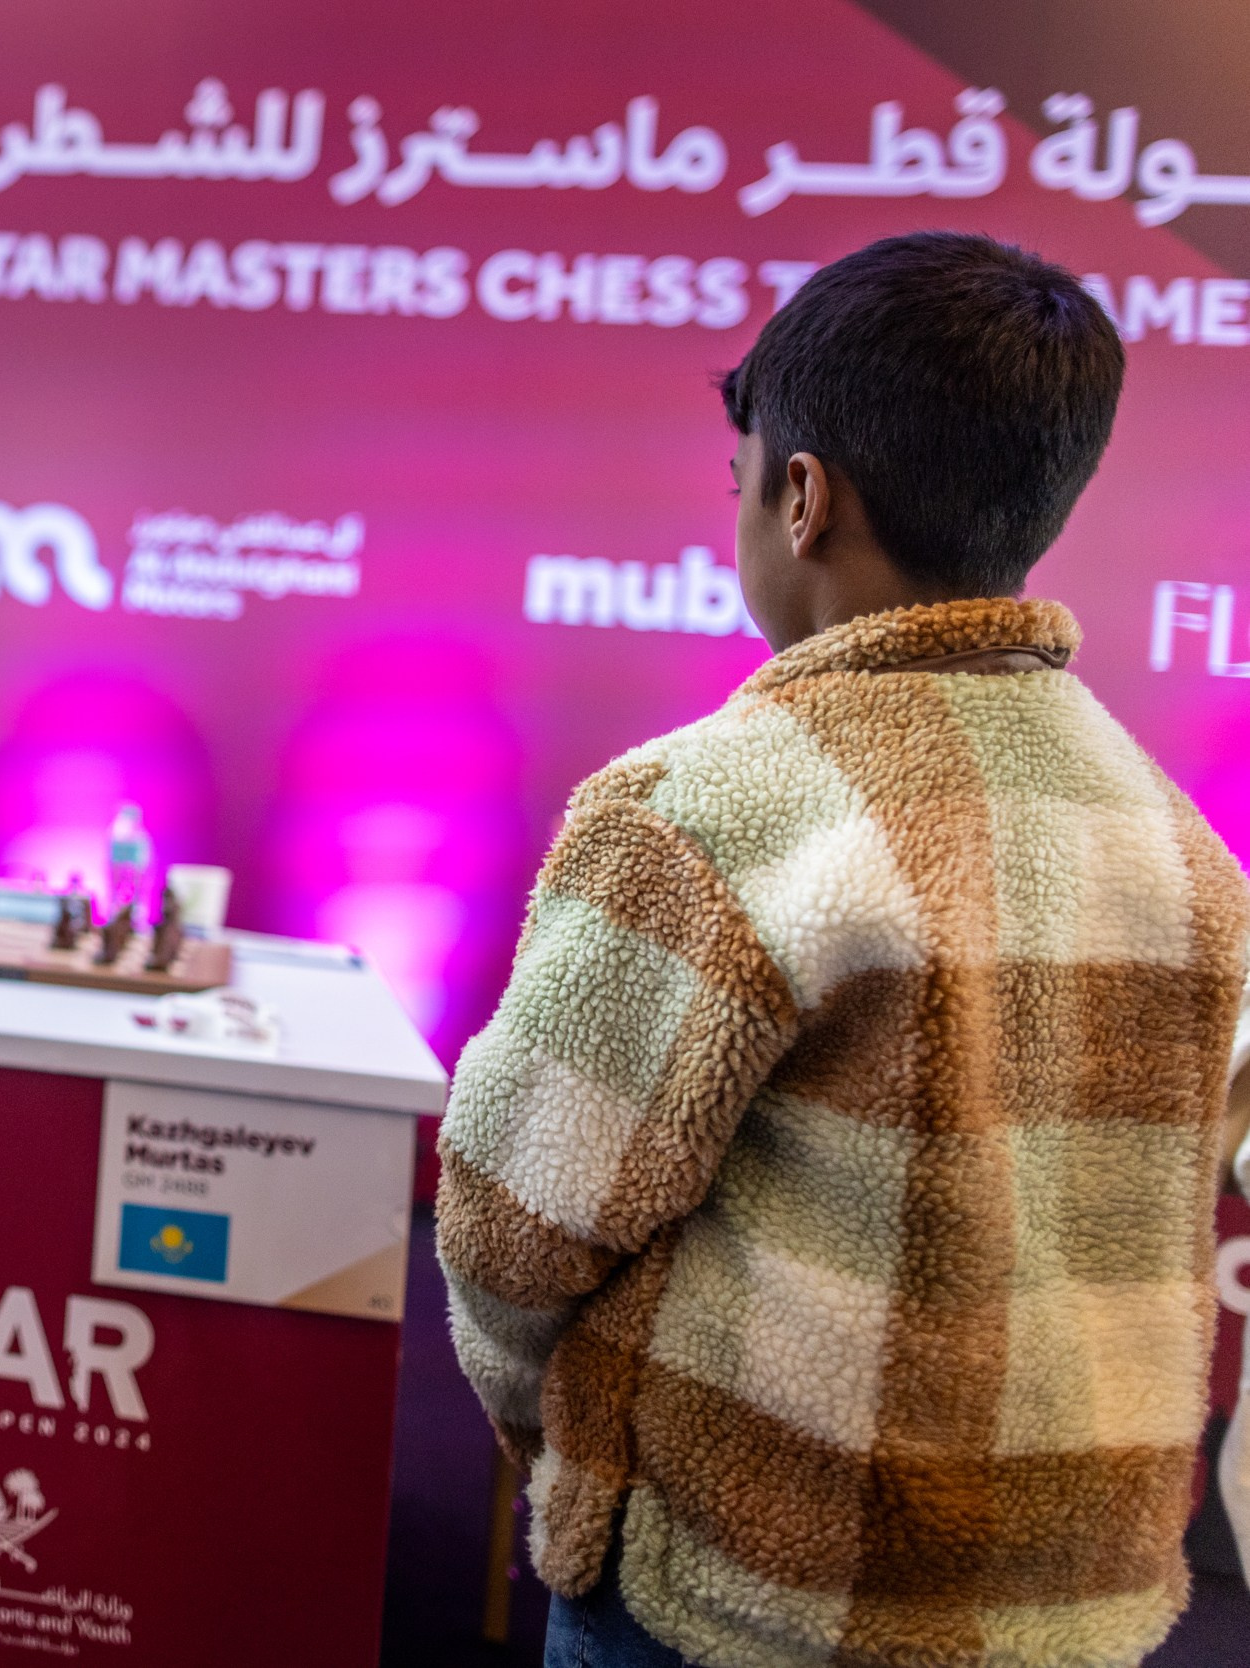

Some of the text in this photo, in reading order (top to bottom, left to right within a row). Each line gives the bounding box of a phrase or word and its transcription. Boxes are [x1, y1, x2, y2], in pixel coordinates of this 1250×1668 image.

[114, 236, 468, 319] MASTERS
[478, 249, 749, 329] CHESS
[124, 1143, 225, 1176] Murtas
[73, 1421, 151, 1451] 2024
[36, 1611, 73, 1636] and
[73, 1613, 132, 1645] Youth
